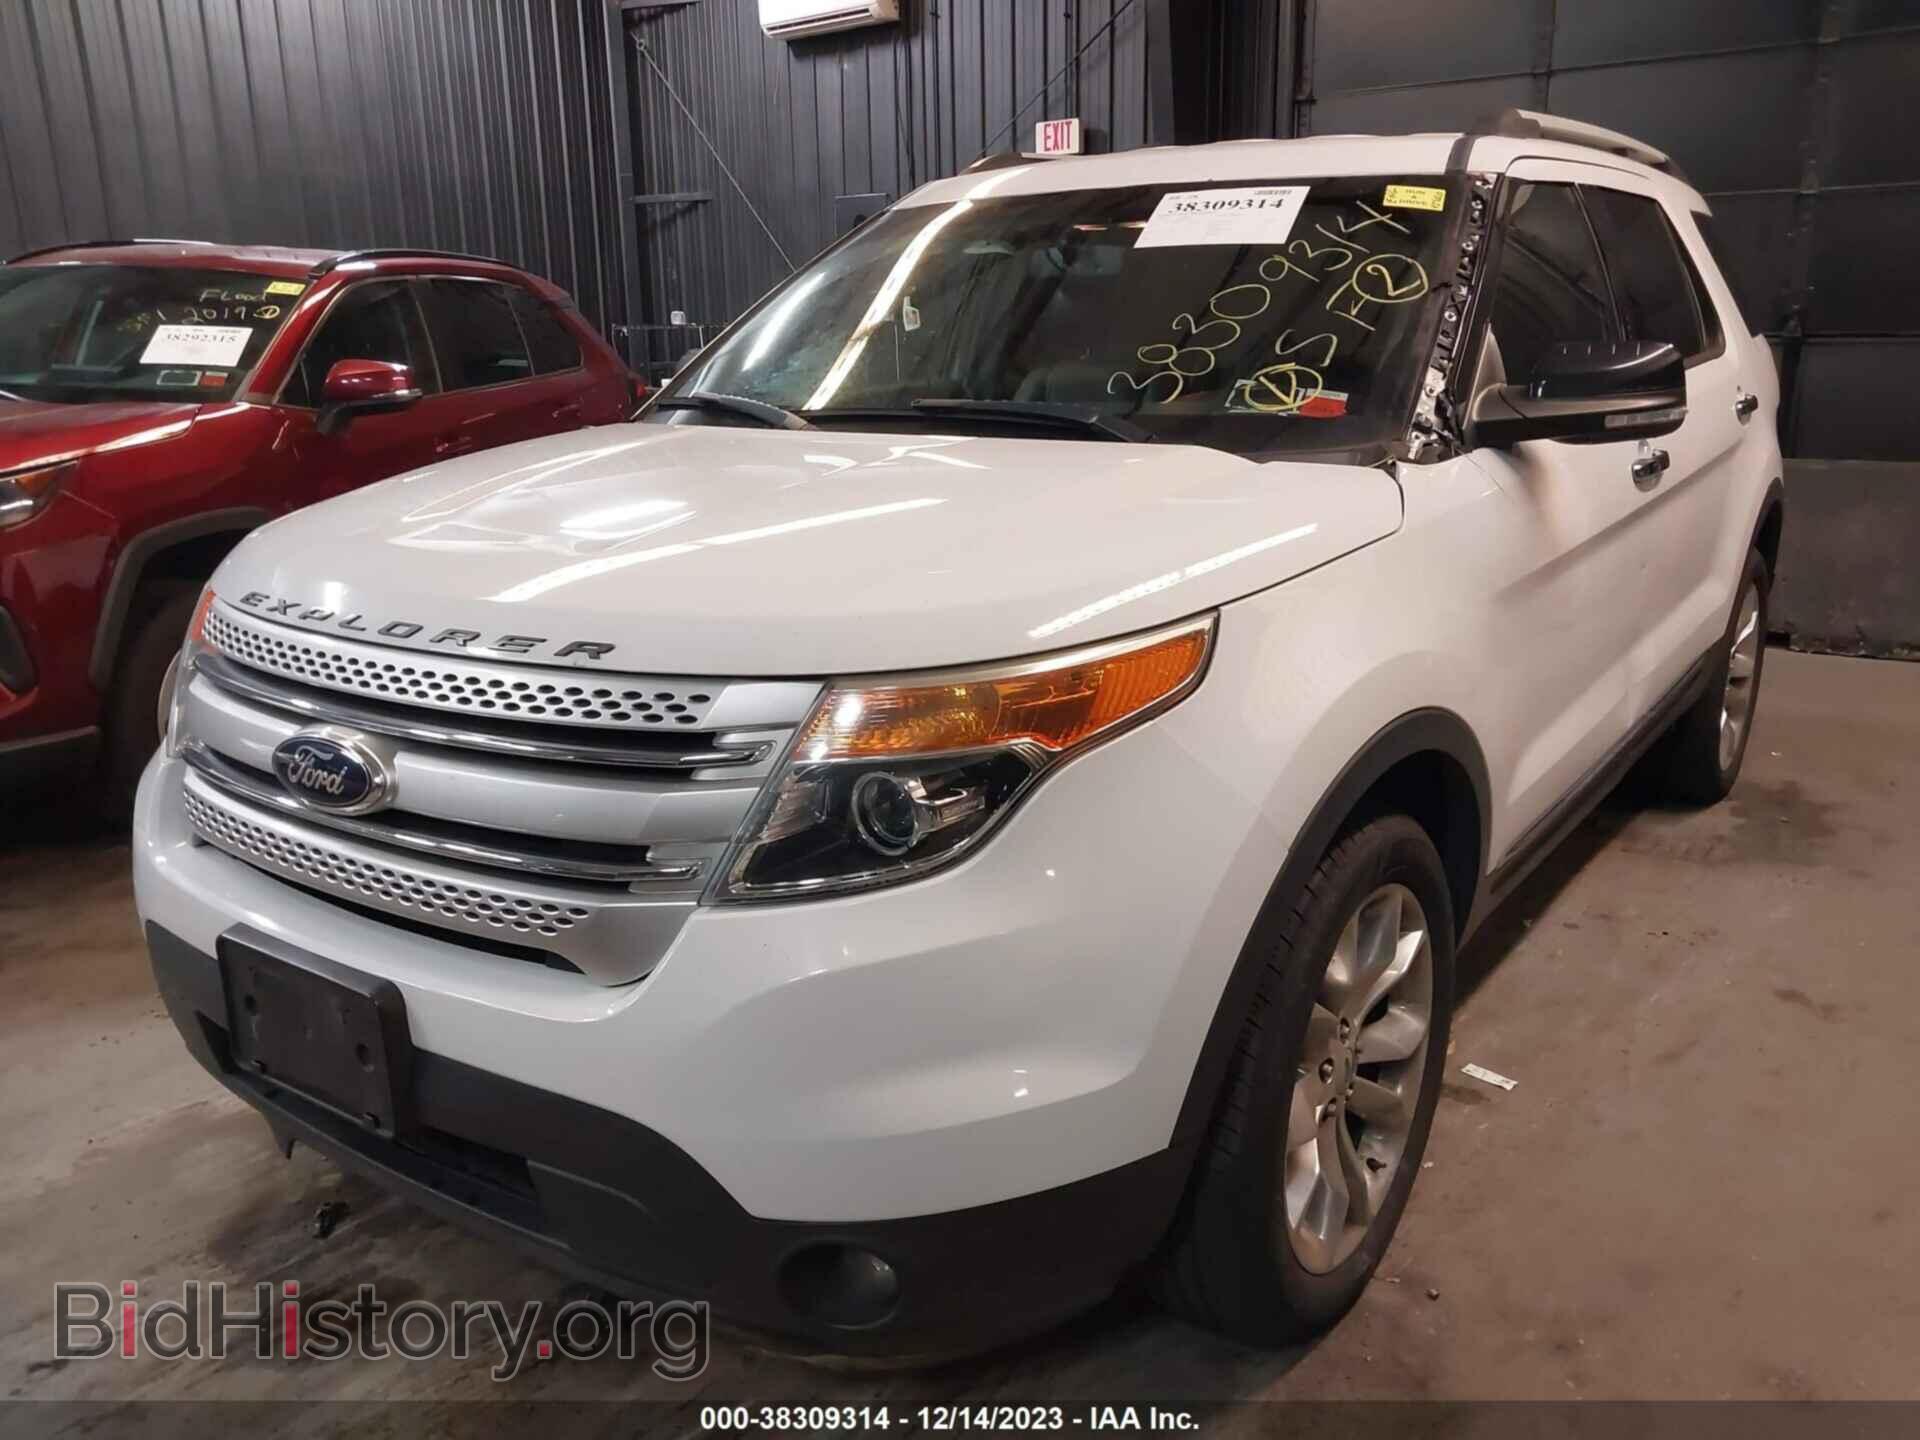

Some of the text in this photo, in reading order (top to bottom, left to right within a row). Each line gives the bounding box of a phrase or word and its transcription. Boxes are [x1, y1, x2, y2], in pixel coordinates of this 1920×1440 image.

[1043, 121, 1072, 151] EXIT
[1169, 198, 1285, 213] 38309314
[240, 591, 616, 661] EXPLORER
[286, 745, 349, 797] Ford
